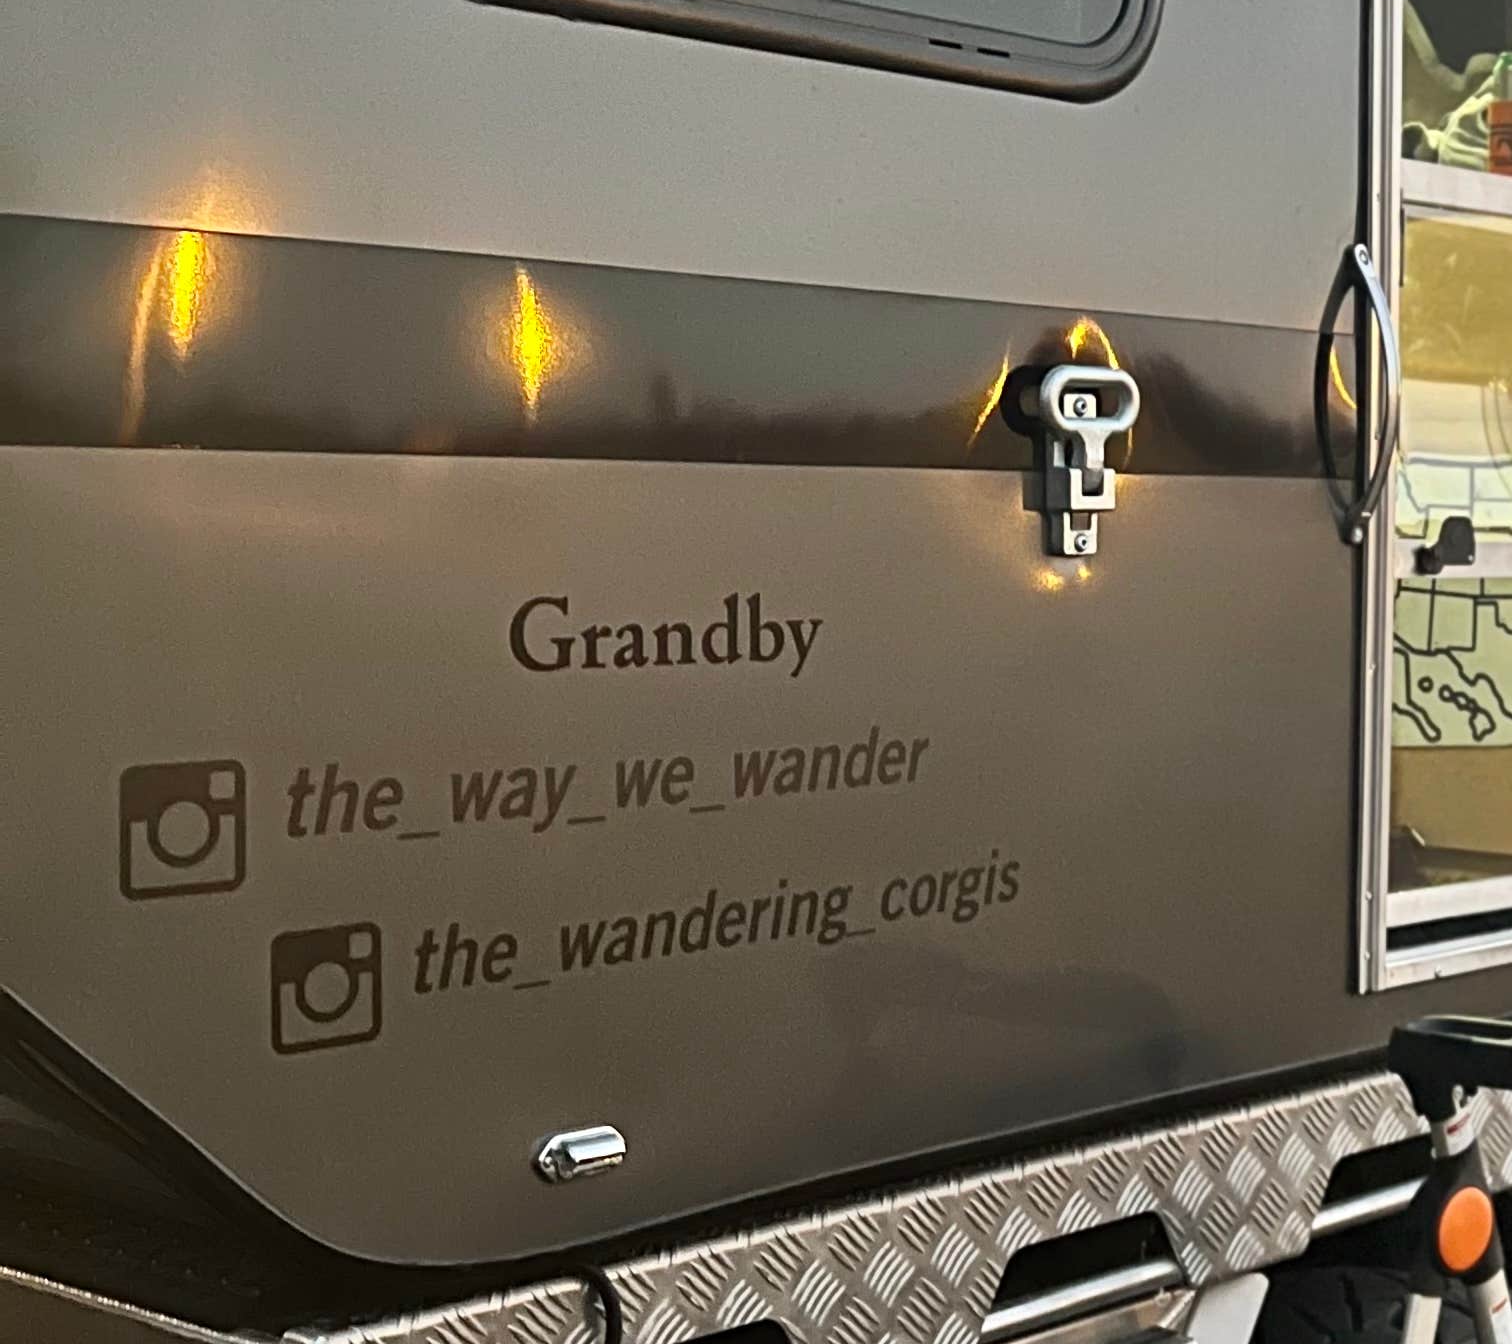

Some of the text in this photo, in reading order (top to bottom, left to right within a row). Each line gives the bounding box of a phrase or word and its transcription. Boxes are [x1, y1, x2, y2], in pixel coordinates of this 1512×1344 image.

[508, 591, 824, 679] Grandby
[285, 725, 931, 841] the_way_we_wander
[412, 847, 1021, 996] the_wandering_corgis
